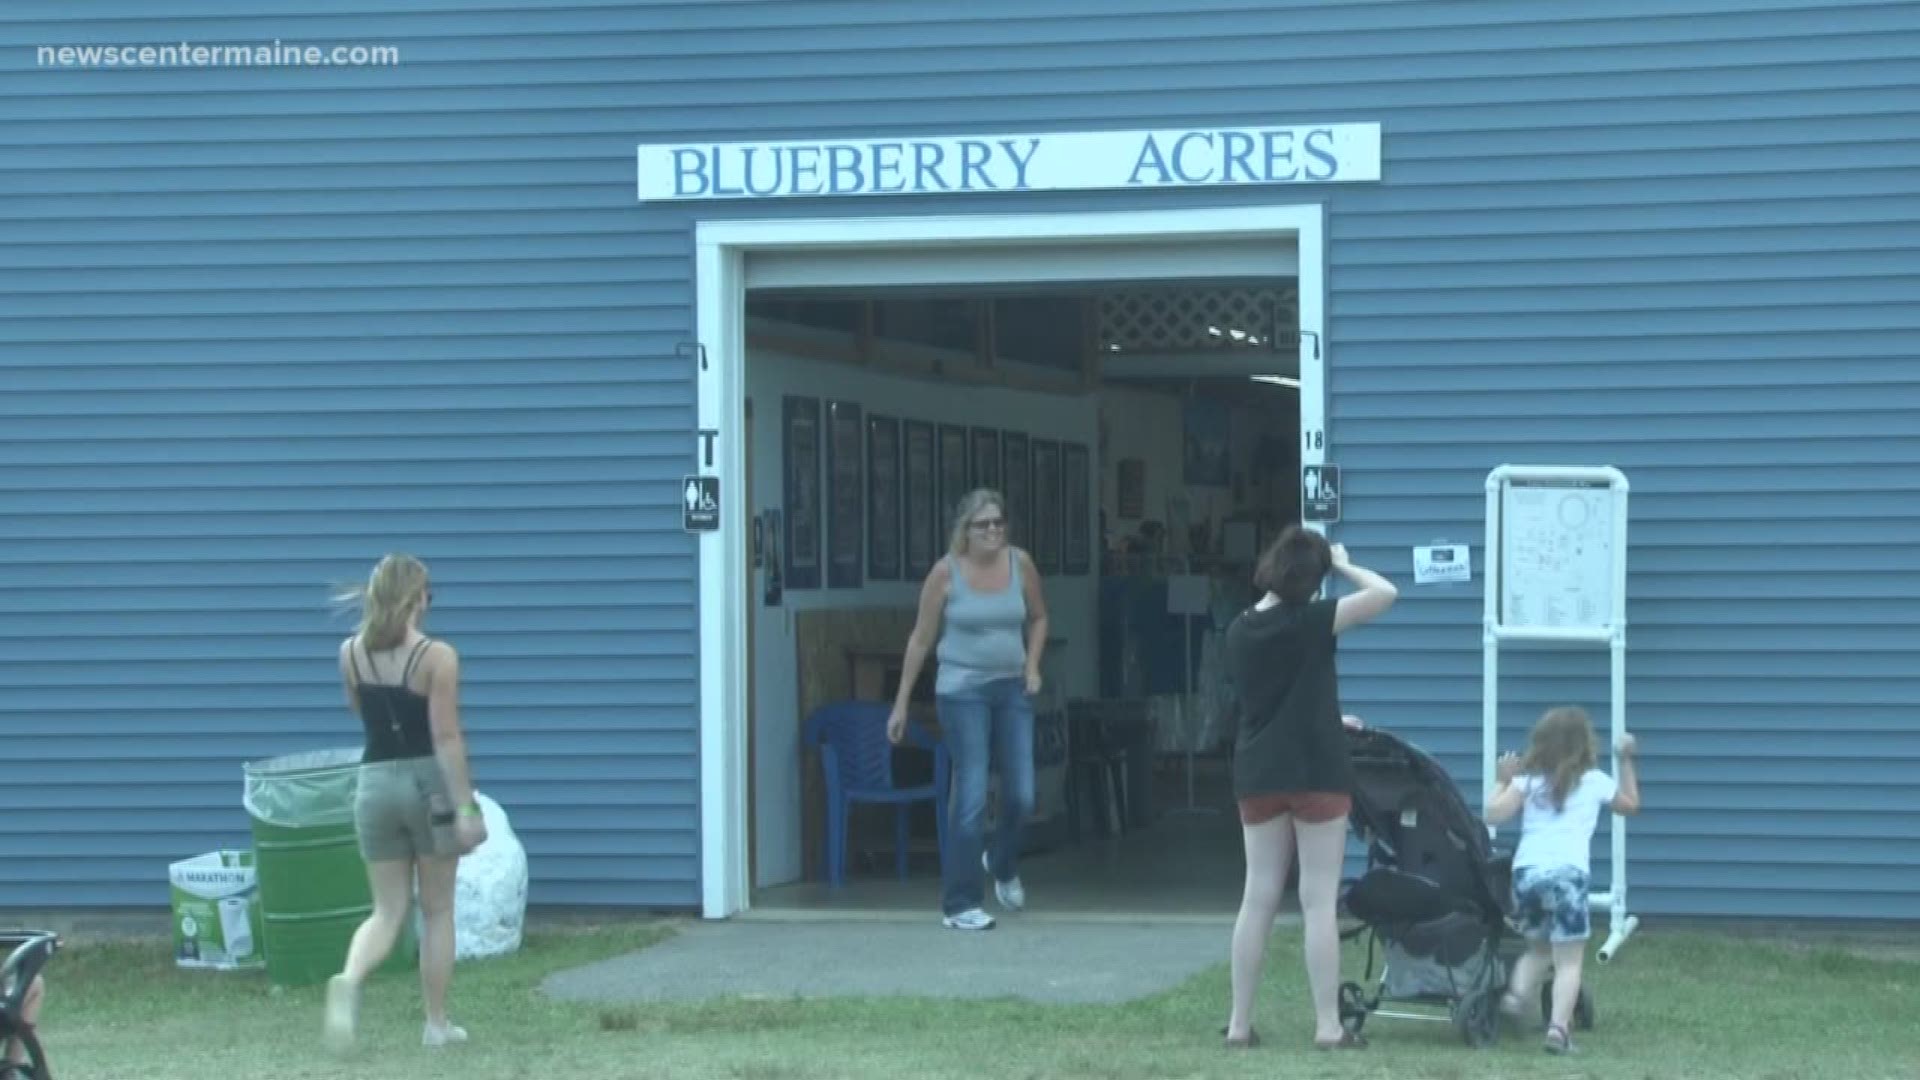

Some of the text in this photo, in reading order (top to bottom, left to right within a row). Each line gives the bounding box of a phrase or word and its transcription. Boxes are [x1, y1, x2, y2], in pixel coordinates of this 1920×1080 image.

[671, 127, 1339, 197] BLUEBERRY ACRES
[1305, 430, 1323, 451] 18
